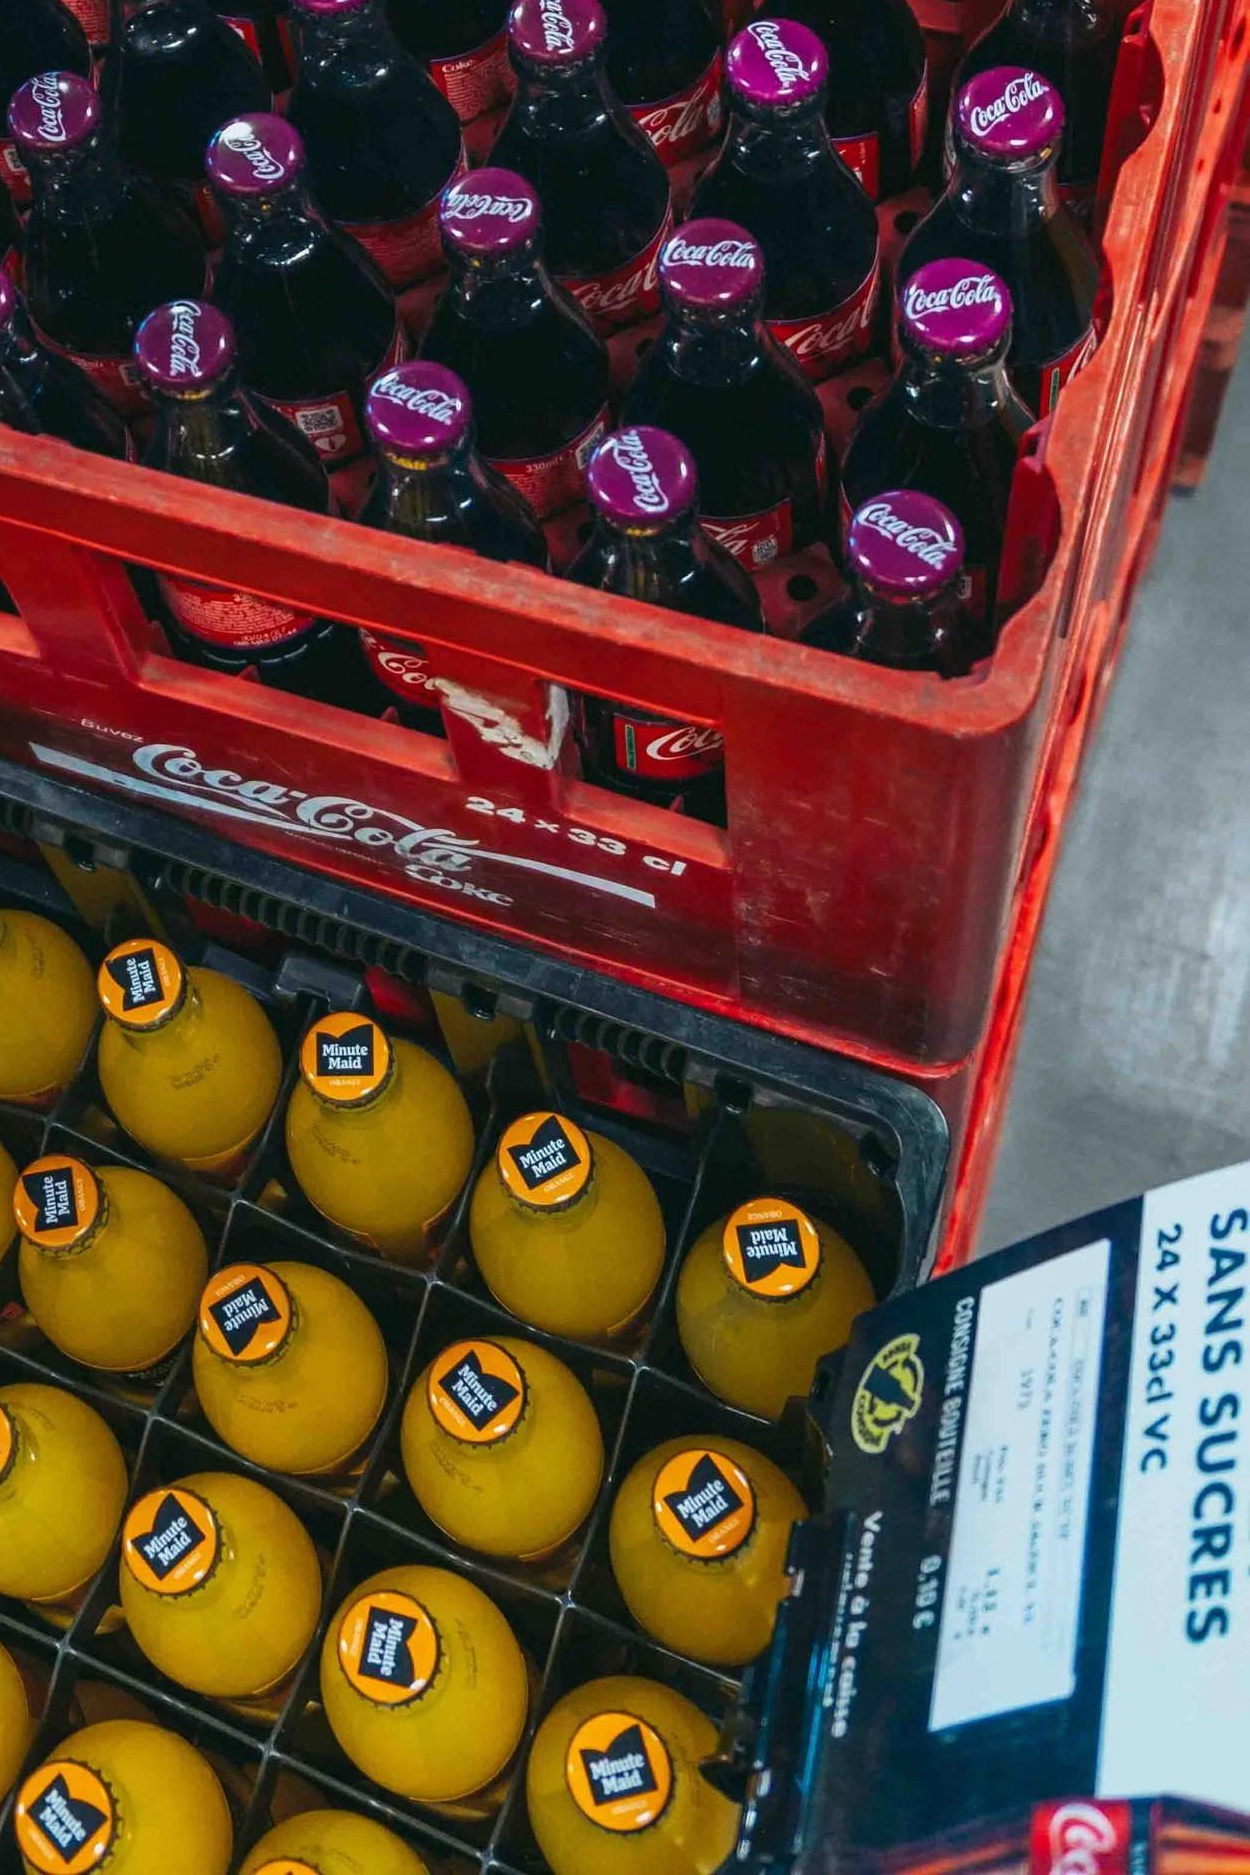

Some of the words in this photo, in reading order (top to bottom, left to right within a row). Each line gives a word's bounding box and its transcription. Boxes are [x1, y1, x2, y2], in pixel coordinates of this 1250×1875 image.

[746, 20, 811, 90] Coca-Cola
[969, 71, 1050, 137] Coca-Cola
[661, 237, 756, 270] Coca-Cola
[904, 275, 1004, 322] Coca-Cola
[168, 298, 204, 379] Coca-Cola
[371, 372, 464, 426] Coca-Cola
[614, 430, 671, 515] Coca-Cola
[852, 501, 958, 569] Coca-Cola
[80, 717, 144, 744] Buvez
[132, 743, 479, 872] Coca-Cola
[465, 796, 526, 824] 24
[567, 828, 627, 856] 33
[643, 855, 687, 876] cl
[321, 1043, 369, 1058] Minute
[327, 1056, 363, 1070] Maid
[518, 1136, 567, 1171] Minute
[530, 1153, 568, 1177] Maid
[745, 1237, 798, 1261] Minute
[749, 1225, 790, 1246] Maid
[1154, 1225, 1183, 1274] 24
[1200, 1208, 1249, 1374] SANS
[943, 1294, 975, 1415] CONSIGNE
[450, 1378, 482, 1418] Maid
[457, 1363, 499, 1414] Minute
[930, 1412, 958, 1508] BOUTEILLE
[1140, 1419, 1173, 1476] VC
[143, 1515, 188, 1561] Minute
[1185, 1397, 1241, 1645] SUCRES
[158, 1531, 192, 1567] Maid
[855, 1511, 884, 1592] Vente
[853, 1596, 870, 1621] à
[368, 1621, 389, 1665] Maid
[378, 1617, 405, 1678] Minute
[847, 1625, 868, 1657] la
[831, 1661, 859, 1739] caisse
[588, 1751, 646, 1782] Minute
[599, 1770, 644, 1793] Maid
